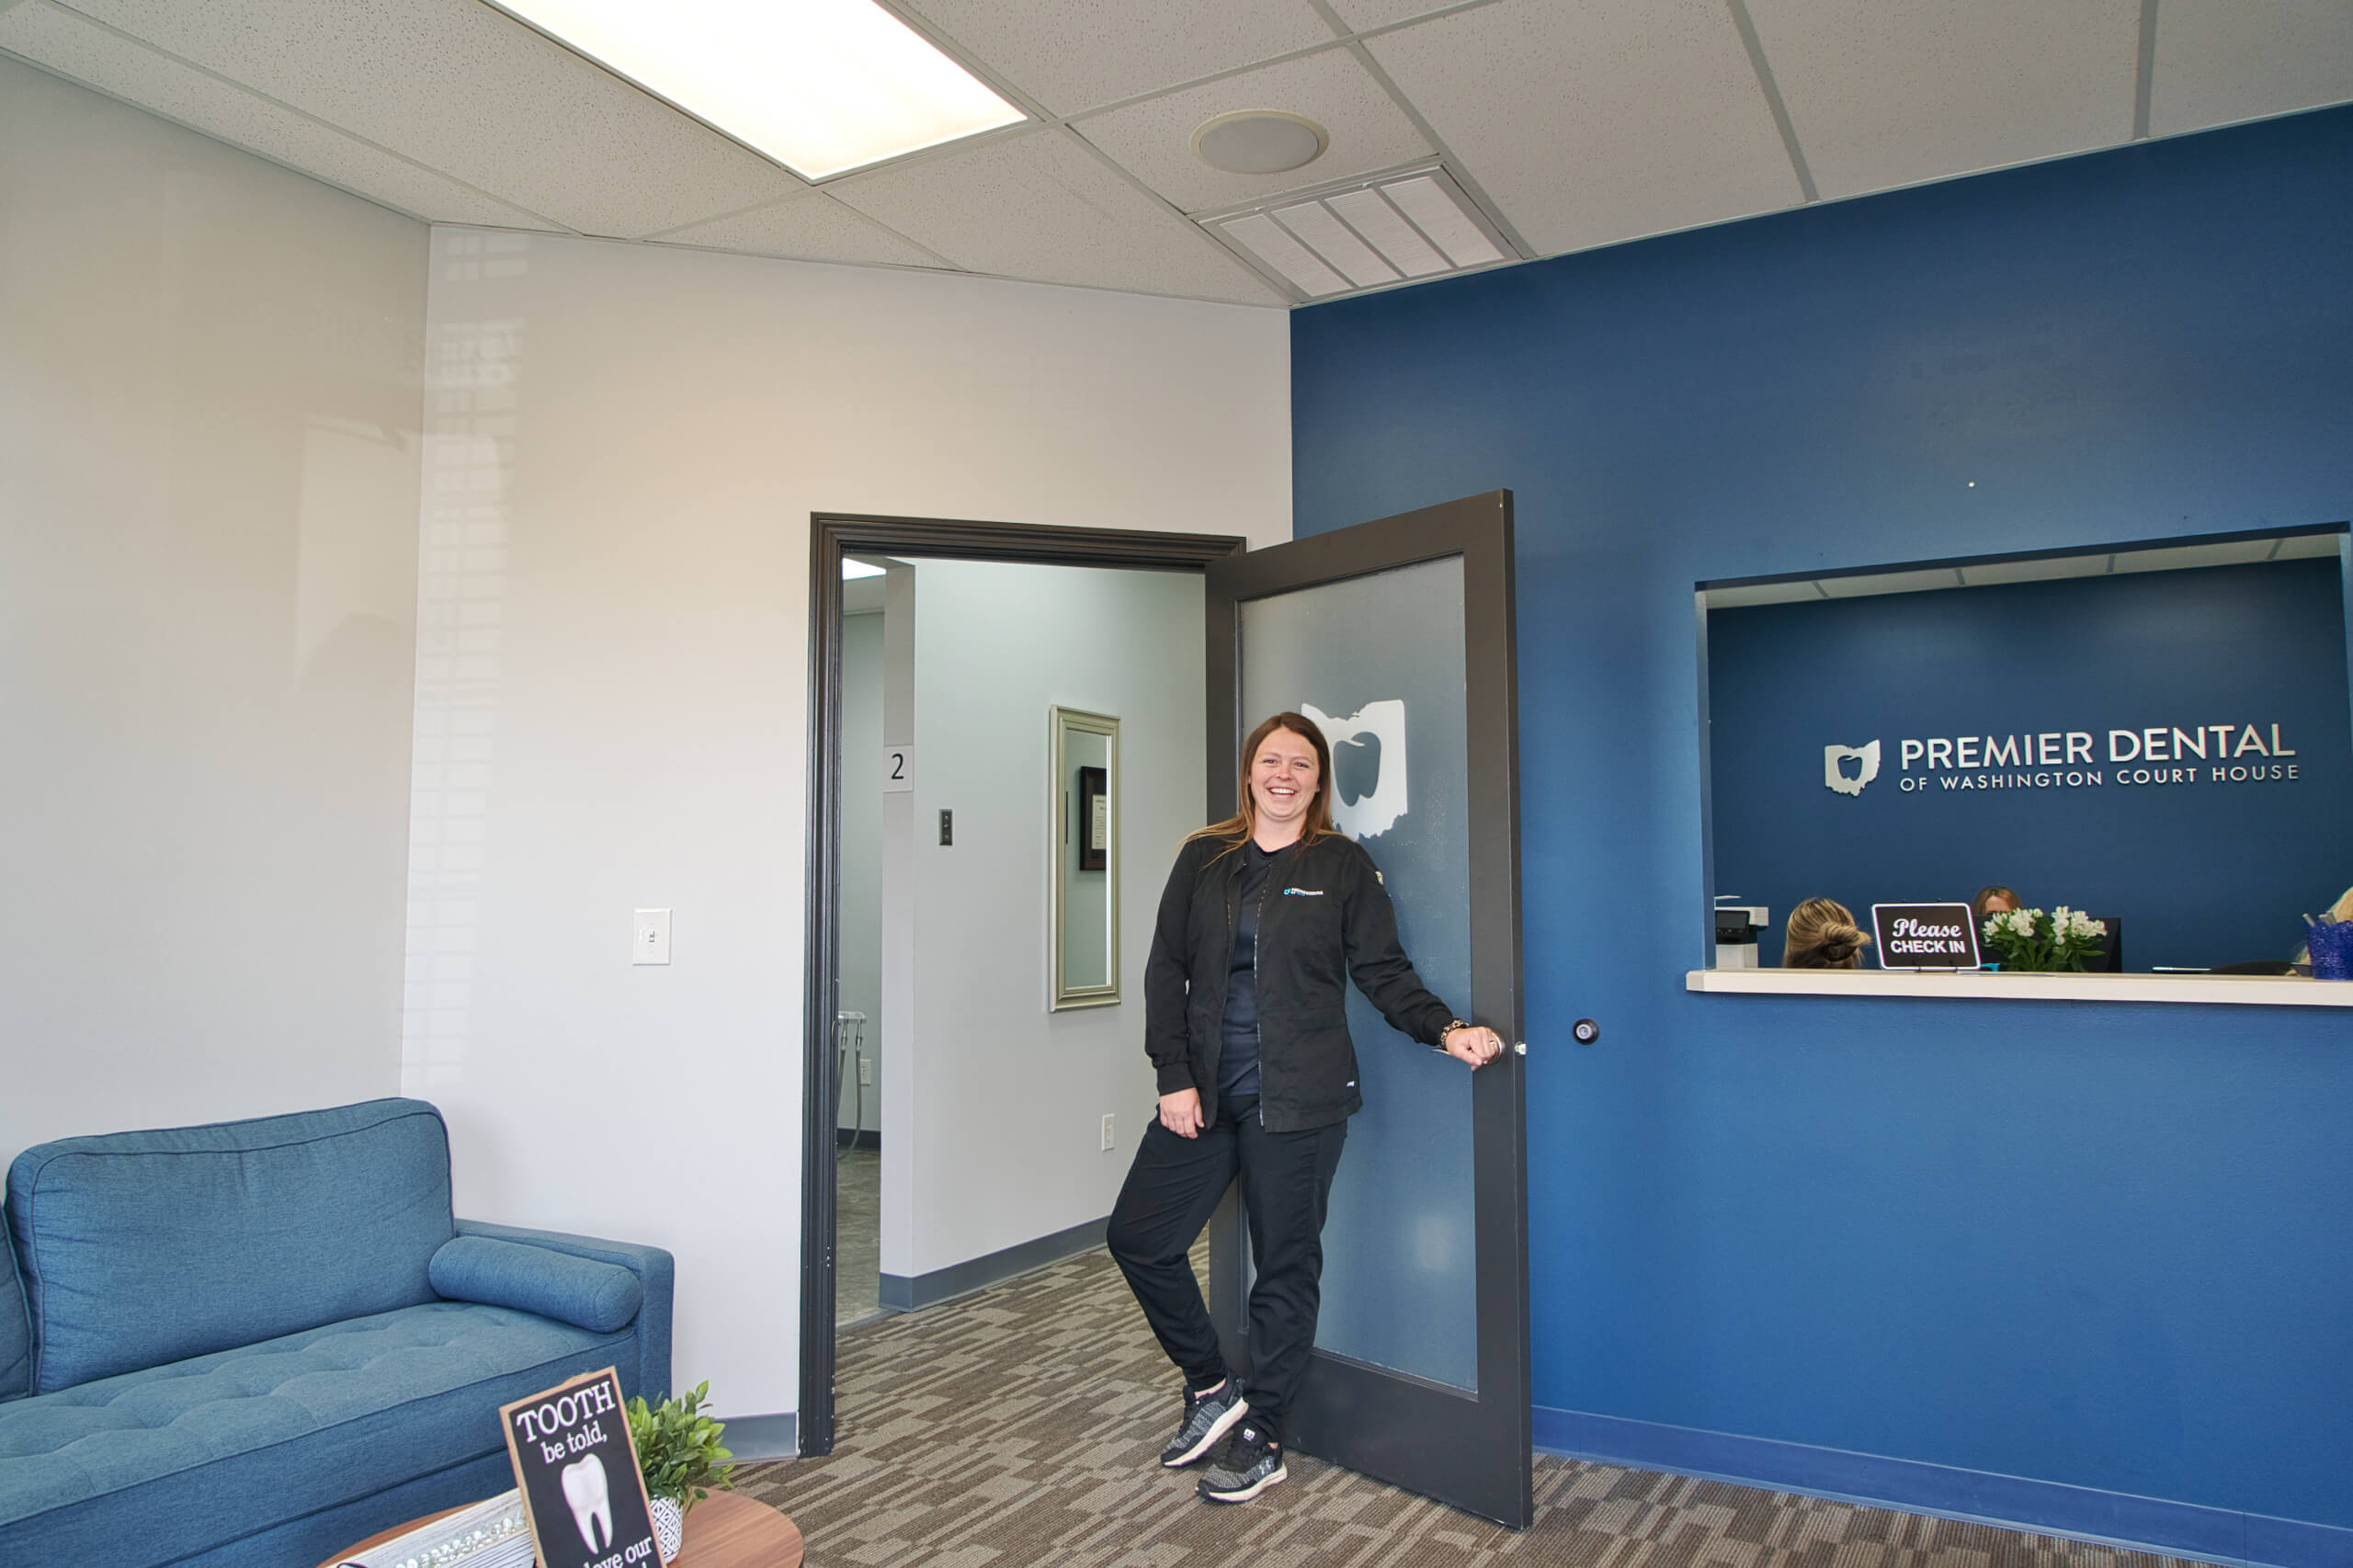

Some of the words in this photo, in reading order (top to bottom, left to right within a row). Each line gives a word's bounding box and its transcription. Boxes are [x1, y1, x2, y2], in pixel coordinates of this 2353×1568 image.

[1901, 732, 2094, 770] PREMIER
[2109, 723, 2296, 762] DENTAL
[891, 753, 904, 779] 2
[1900, 778, 1927, 791] OF
[1940, 771, 2102, 790] WASHINGTON
[2116, 768, 2197, 784] COURT
[2212, 765, 2299, 781] HOUSE
[1892, 918, 1962, 937] Please
[1890, 939, 1948, 954] CHECK
[1949, 940, 1966, 954] IN
[516, 1381, 617, 1443] TOOTH
[540, 1441, 566, 1464] be
[566, 1419, 608, 1453] told,
[583, 1553, 624, 1568] ve
[625, 1536, 653, 1563] our
